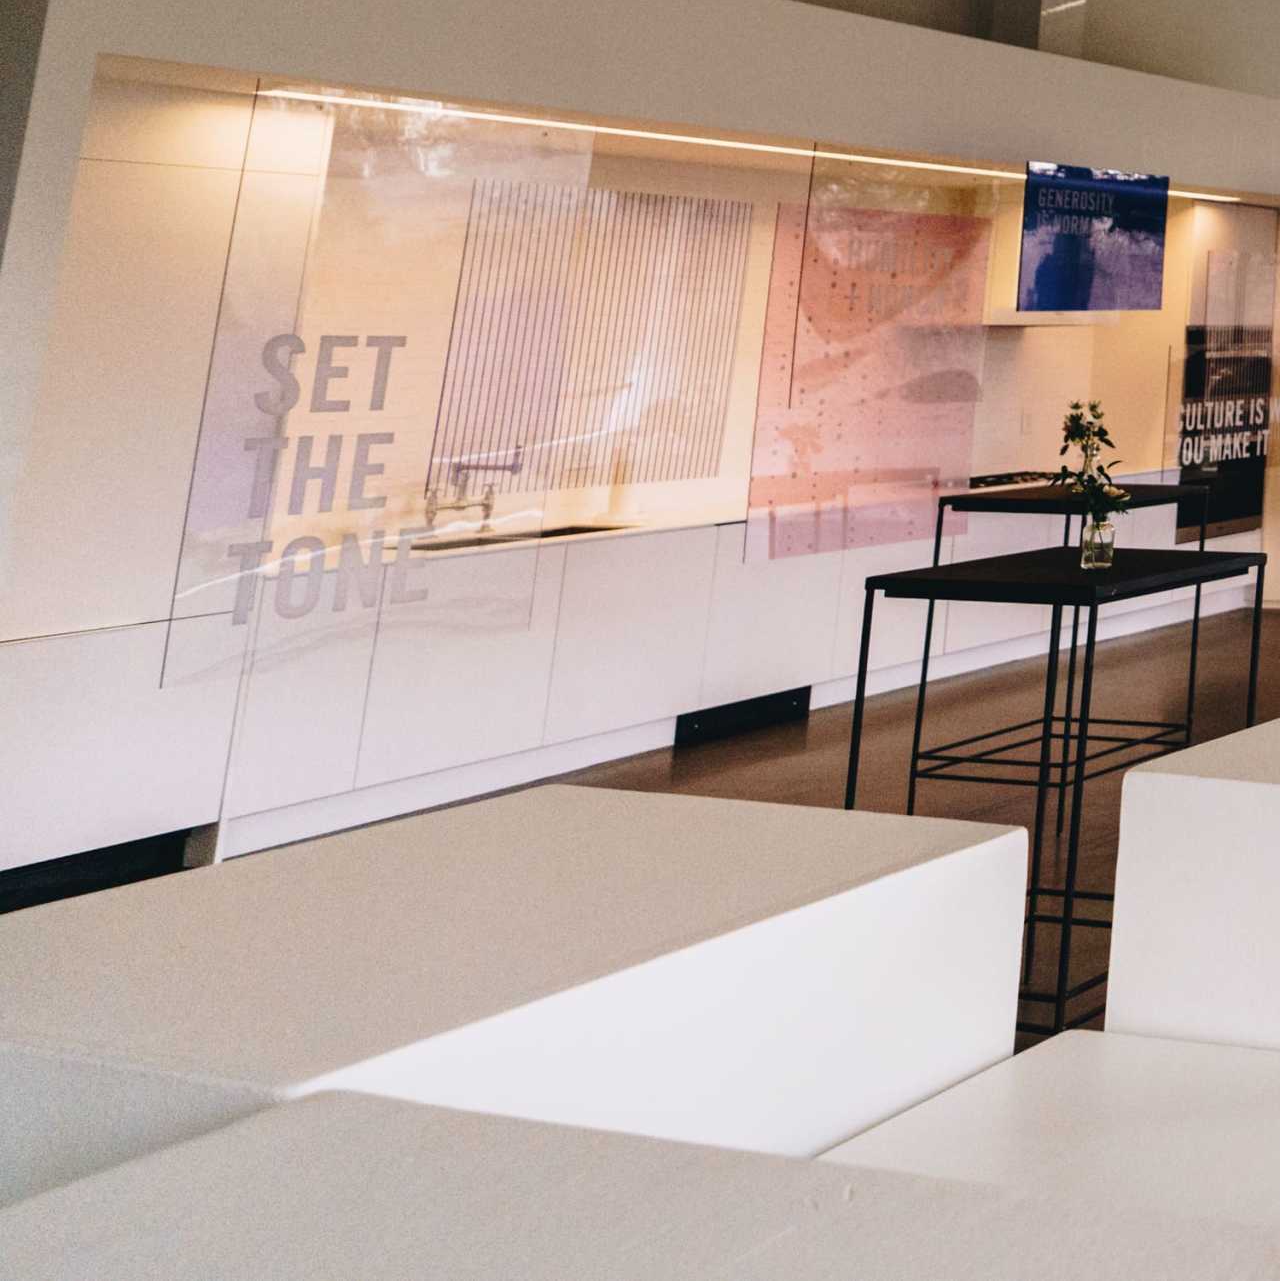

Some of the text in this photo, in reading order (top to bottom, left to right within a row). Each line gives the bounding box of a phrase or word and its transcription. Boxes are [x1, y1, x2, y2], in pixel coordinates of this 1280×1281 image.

[1037, 189, 1116, 213] GENEROSITY
[253, 333, 407, 415] SET
[1178, 399, 1244, 432] CULTURE
[1249, 397, 1265, 426] IS
[1209, 430, 1251, 462] MAKE
[1256, 428, 1270, 456] IT
[243, 430, 395, 519] THE
[228, 526, 430, 626] TONE
